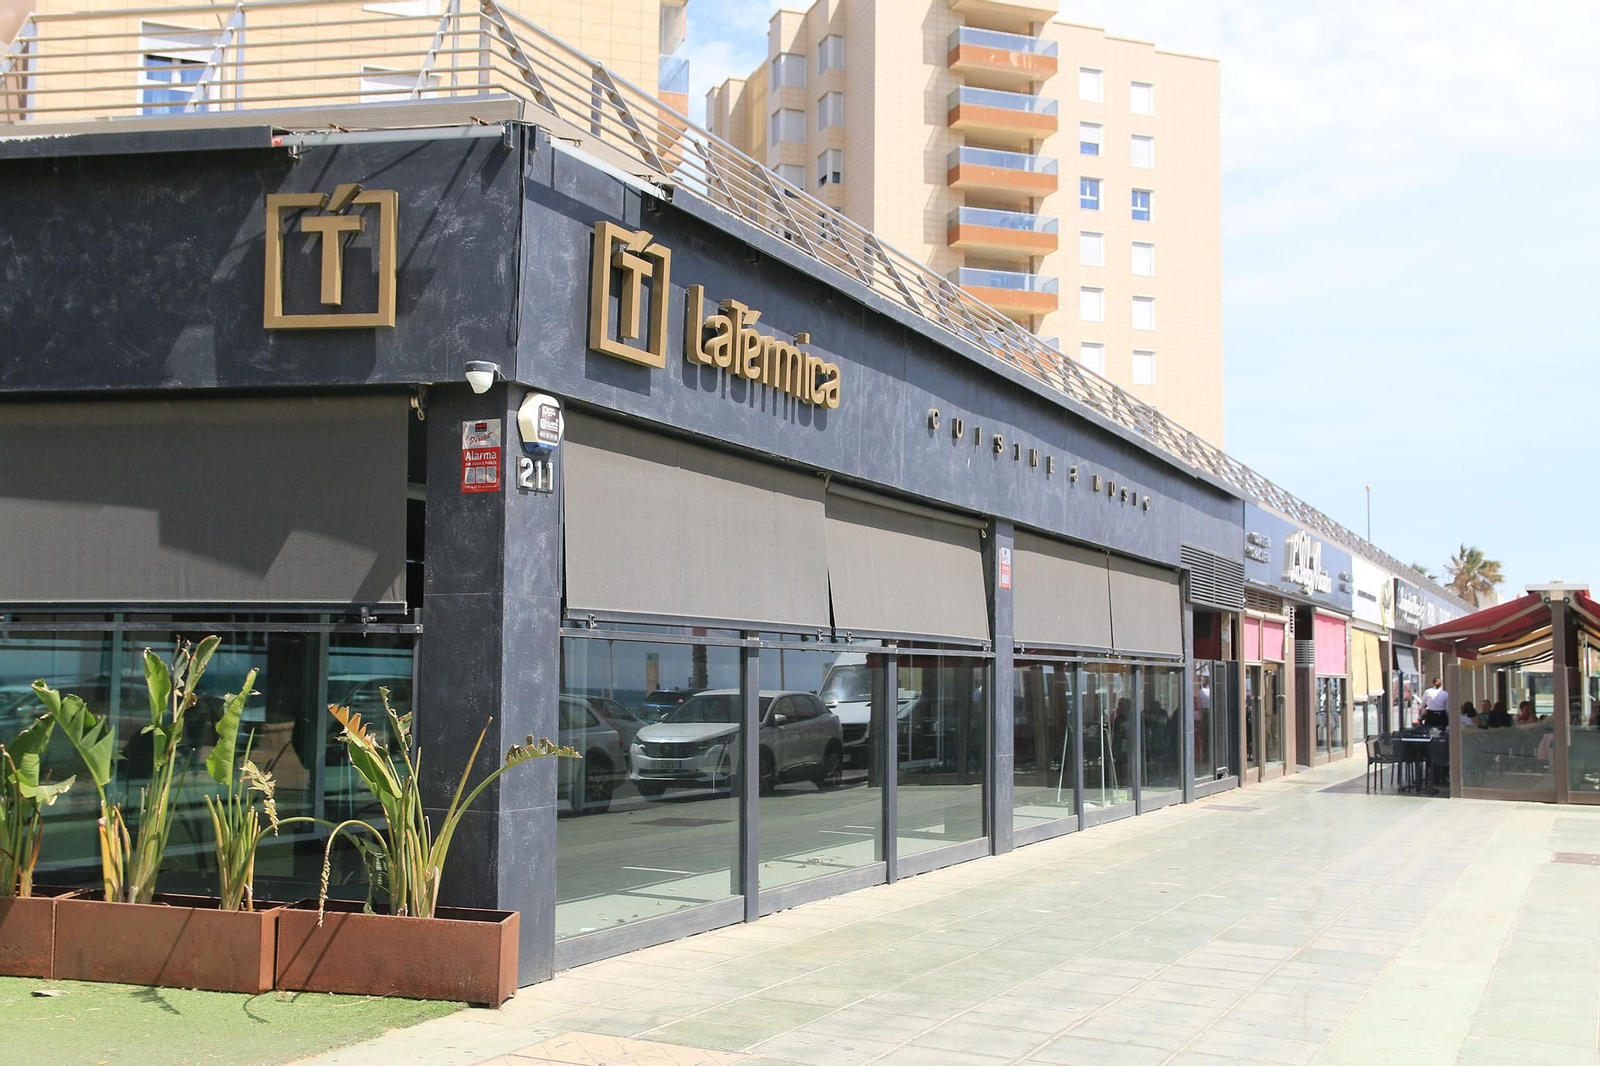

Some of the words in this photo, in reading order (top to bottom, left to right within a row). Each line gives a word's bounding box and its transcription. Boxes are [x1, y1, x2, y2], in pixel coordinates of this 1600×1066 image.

[465, 450, 497, 461] Alarma
[926, 407, 1055, 475] CUISINE
[1092, 474, 1151, 512] MUSIC
[519, 457, 555, 491] 211
